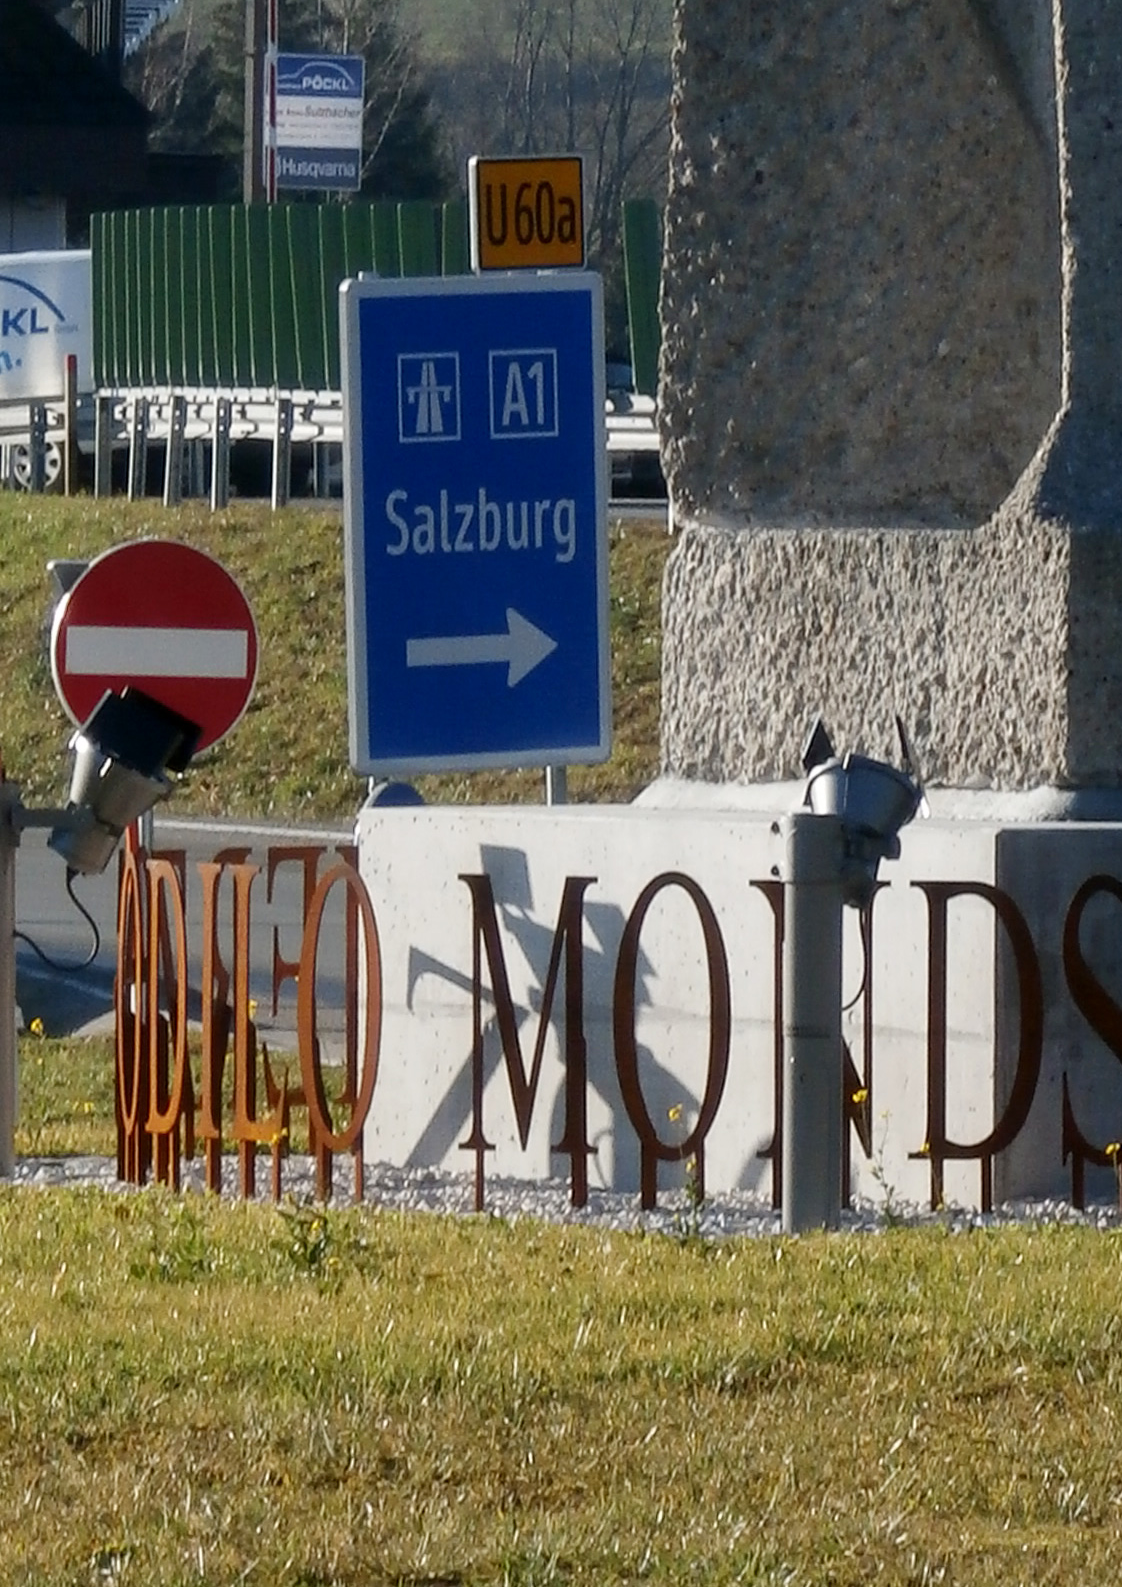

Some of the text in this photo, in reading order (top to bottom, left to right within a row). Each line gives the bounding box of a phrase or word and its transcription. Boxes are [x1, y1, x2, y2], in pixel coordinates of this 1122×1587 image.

[282, 158, 356, 177] Husqvarna
[501, 360, 546, 427] A1
[385, 486, 577, 564] Salzburg
